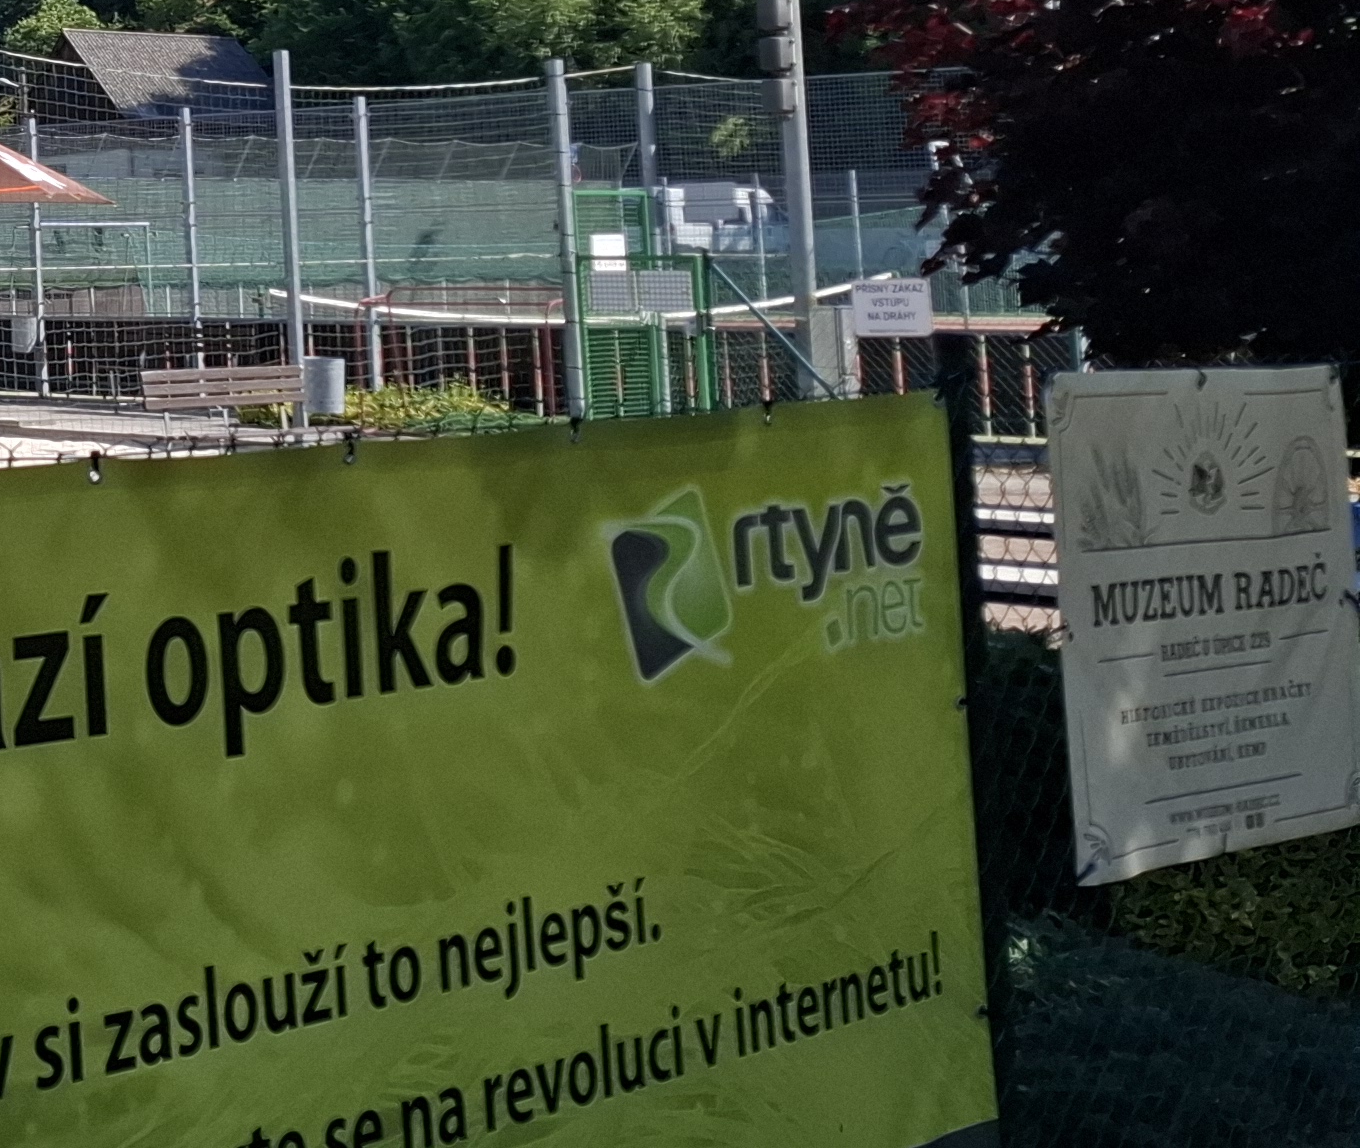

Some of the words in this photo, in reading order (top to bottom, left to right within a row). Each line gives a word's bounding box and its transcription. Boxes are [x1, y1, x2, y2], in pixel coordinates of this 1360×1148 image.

[867, 312, 881, 321] NA
[883, 311, 917, 321] DRÁHY
[871, 298, 910, 307] VSTUPU
[733, 483, 923, 602] rtyně
[1091, 573, 1225, 627] MUZEUM
[1234, 553, 1328, 611] RADEČ
[145, 542, 518, 759] optika!
[826, 577, 923, 649] .net
[34, 996, 84, 1091] si
[103, 943, 349, 1076] zaslouží
[363, 940, 422, 1009] to
[438, 877, 662, 1000] nejlepší.
[401, 1087, 467, 1148] na
[483, 1006, 685, 1133] revoluci
[695, 1013, 722, 1068] v
[734, 930, 944, 1058] internetu!
